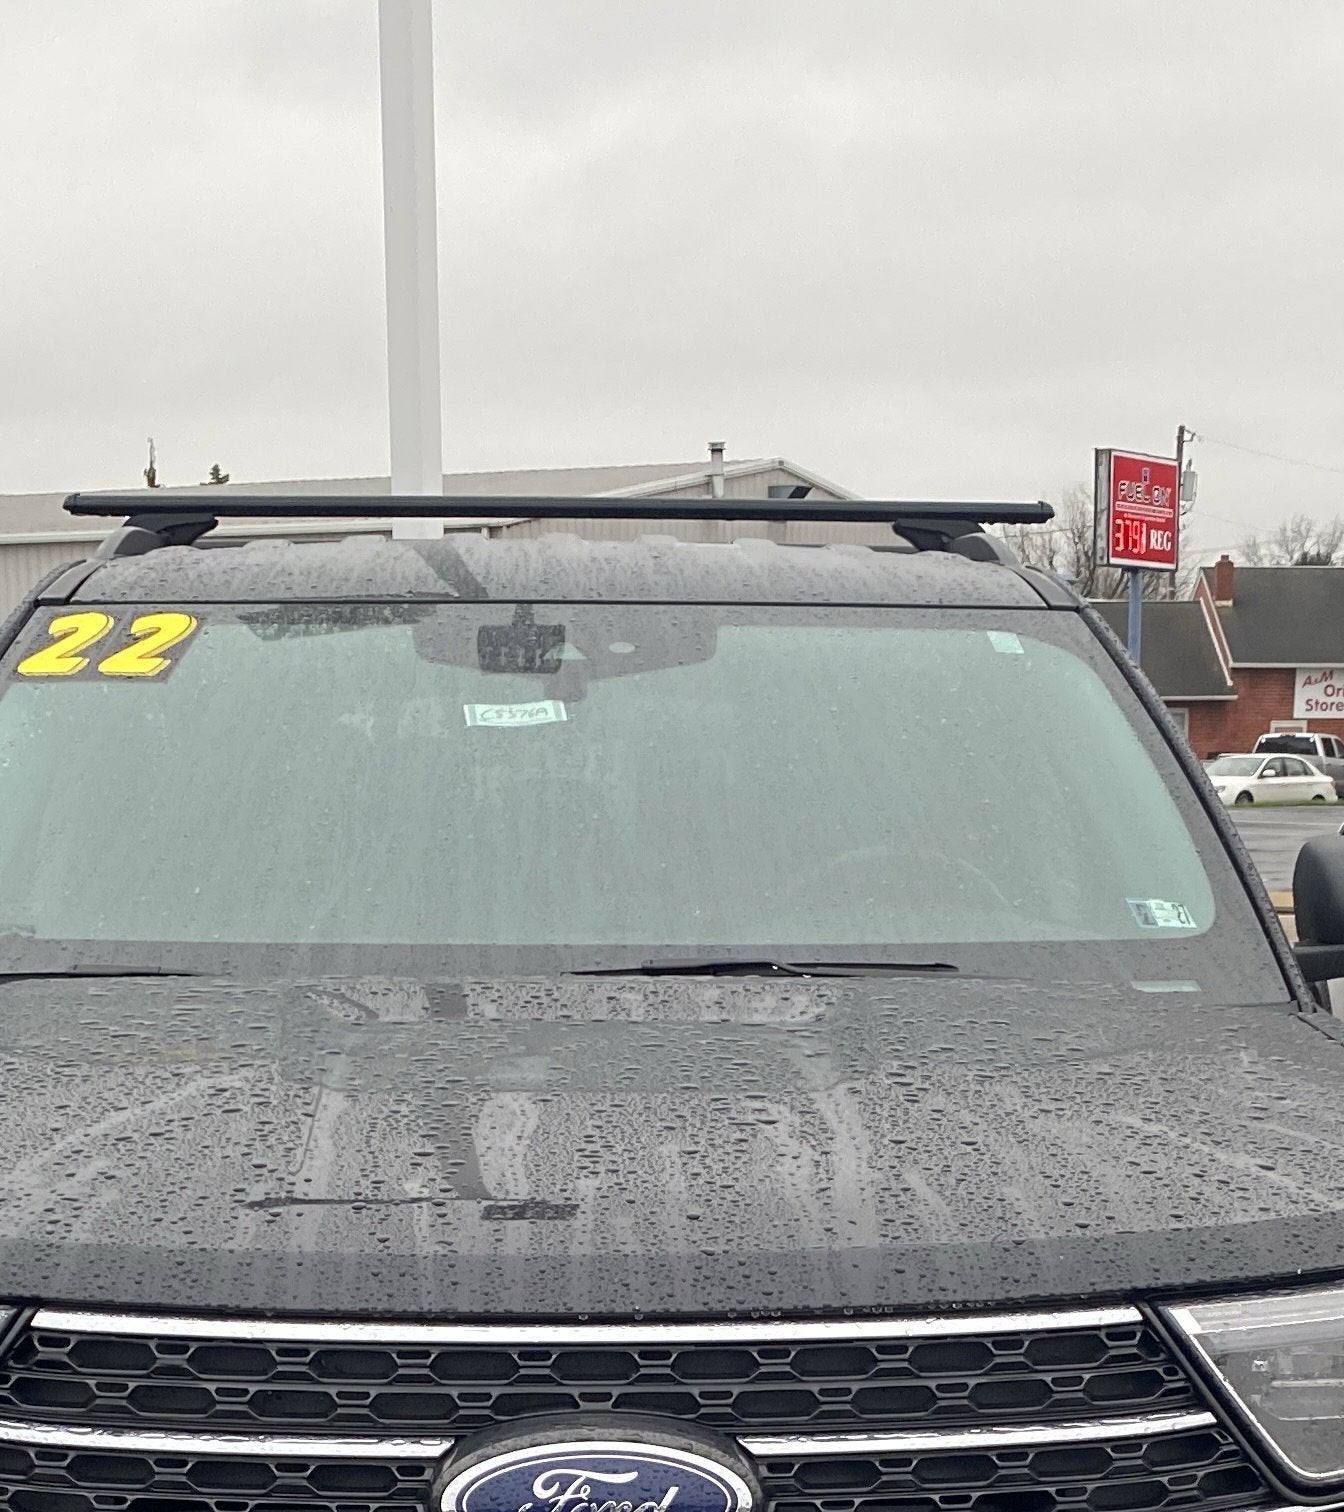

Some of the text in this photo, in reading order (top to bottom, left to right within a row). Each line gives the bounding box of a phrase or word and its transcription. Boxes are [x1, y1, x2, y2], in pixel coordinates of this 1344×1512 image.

[1118, 480, 1150, 503] FUEL
[1150, 529, 1172, 551] REG
[17, 611, 197, 676] 22
[1305, 699, 1344, 712] Store
